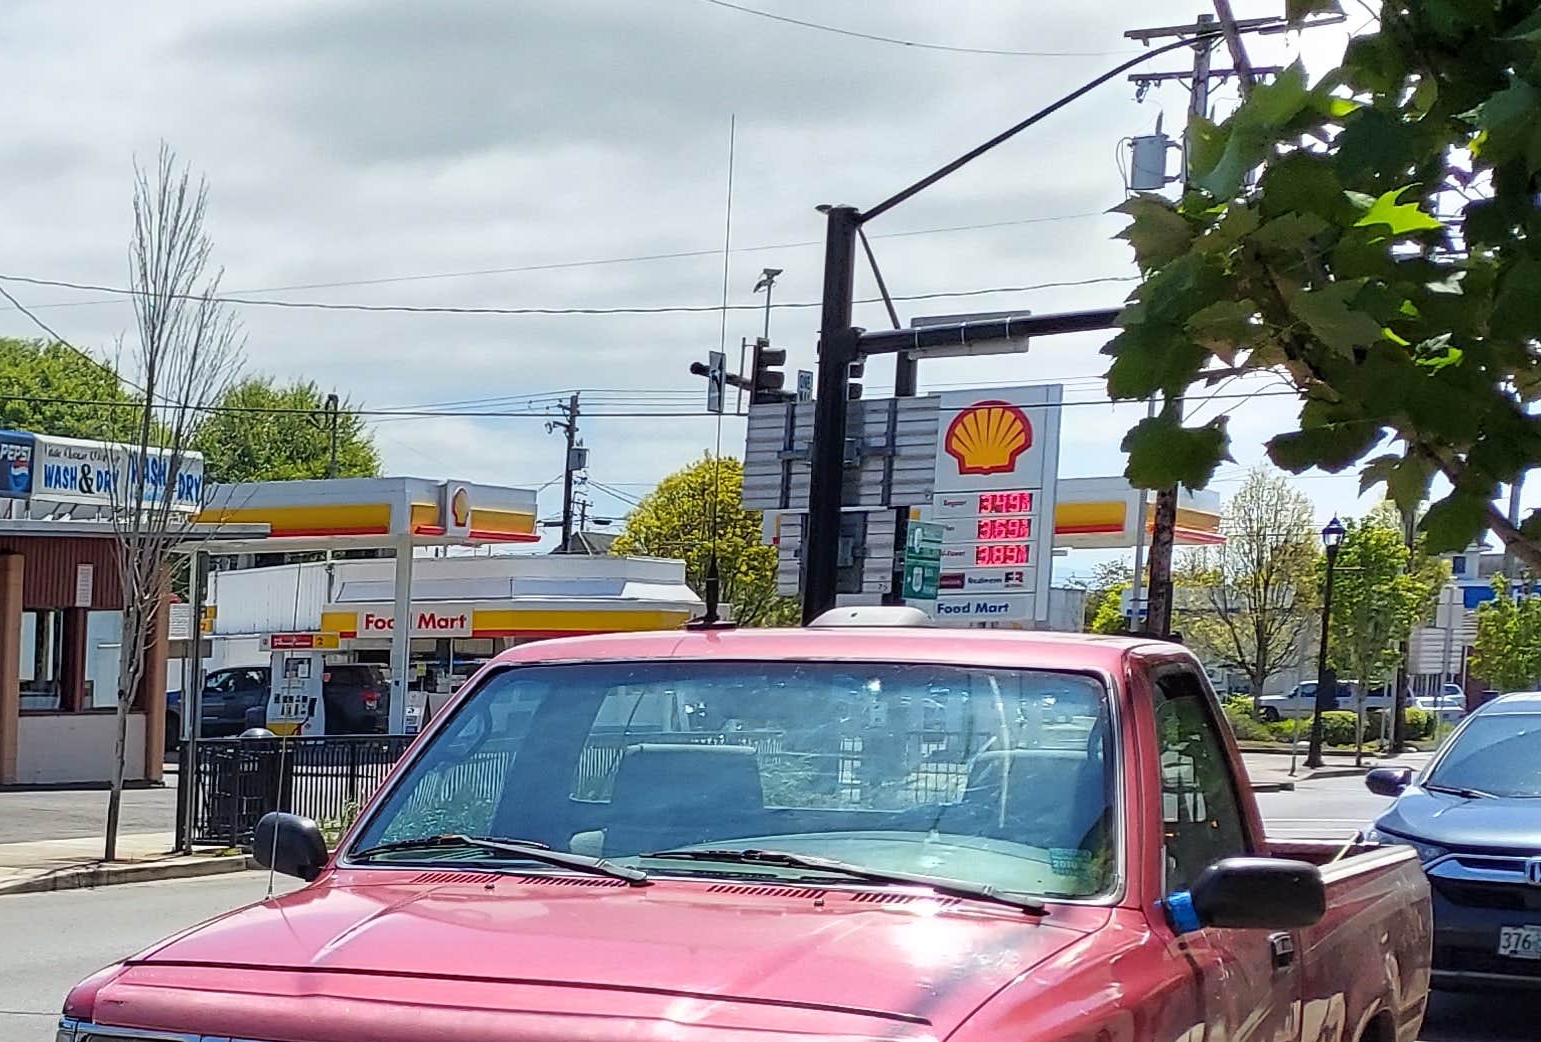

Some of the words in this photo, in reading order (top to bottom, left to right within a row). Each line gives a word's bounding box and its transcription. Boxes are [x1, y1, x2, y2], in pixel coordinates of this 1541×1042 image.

[0, 444, 32, 461] PEPSI
[44, 464, 77, 490] WASH
[79, 463, 95, 494] &
[96, 469, 120, 493] DRY
[177, 472, 202, 502] DRY
[937, 602, 971, 614] Food
[974, 602, 1009, 614] Mart
[417, 613, 467, 629] Mart
[1502, 932, 1532, 950] 376
